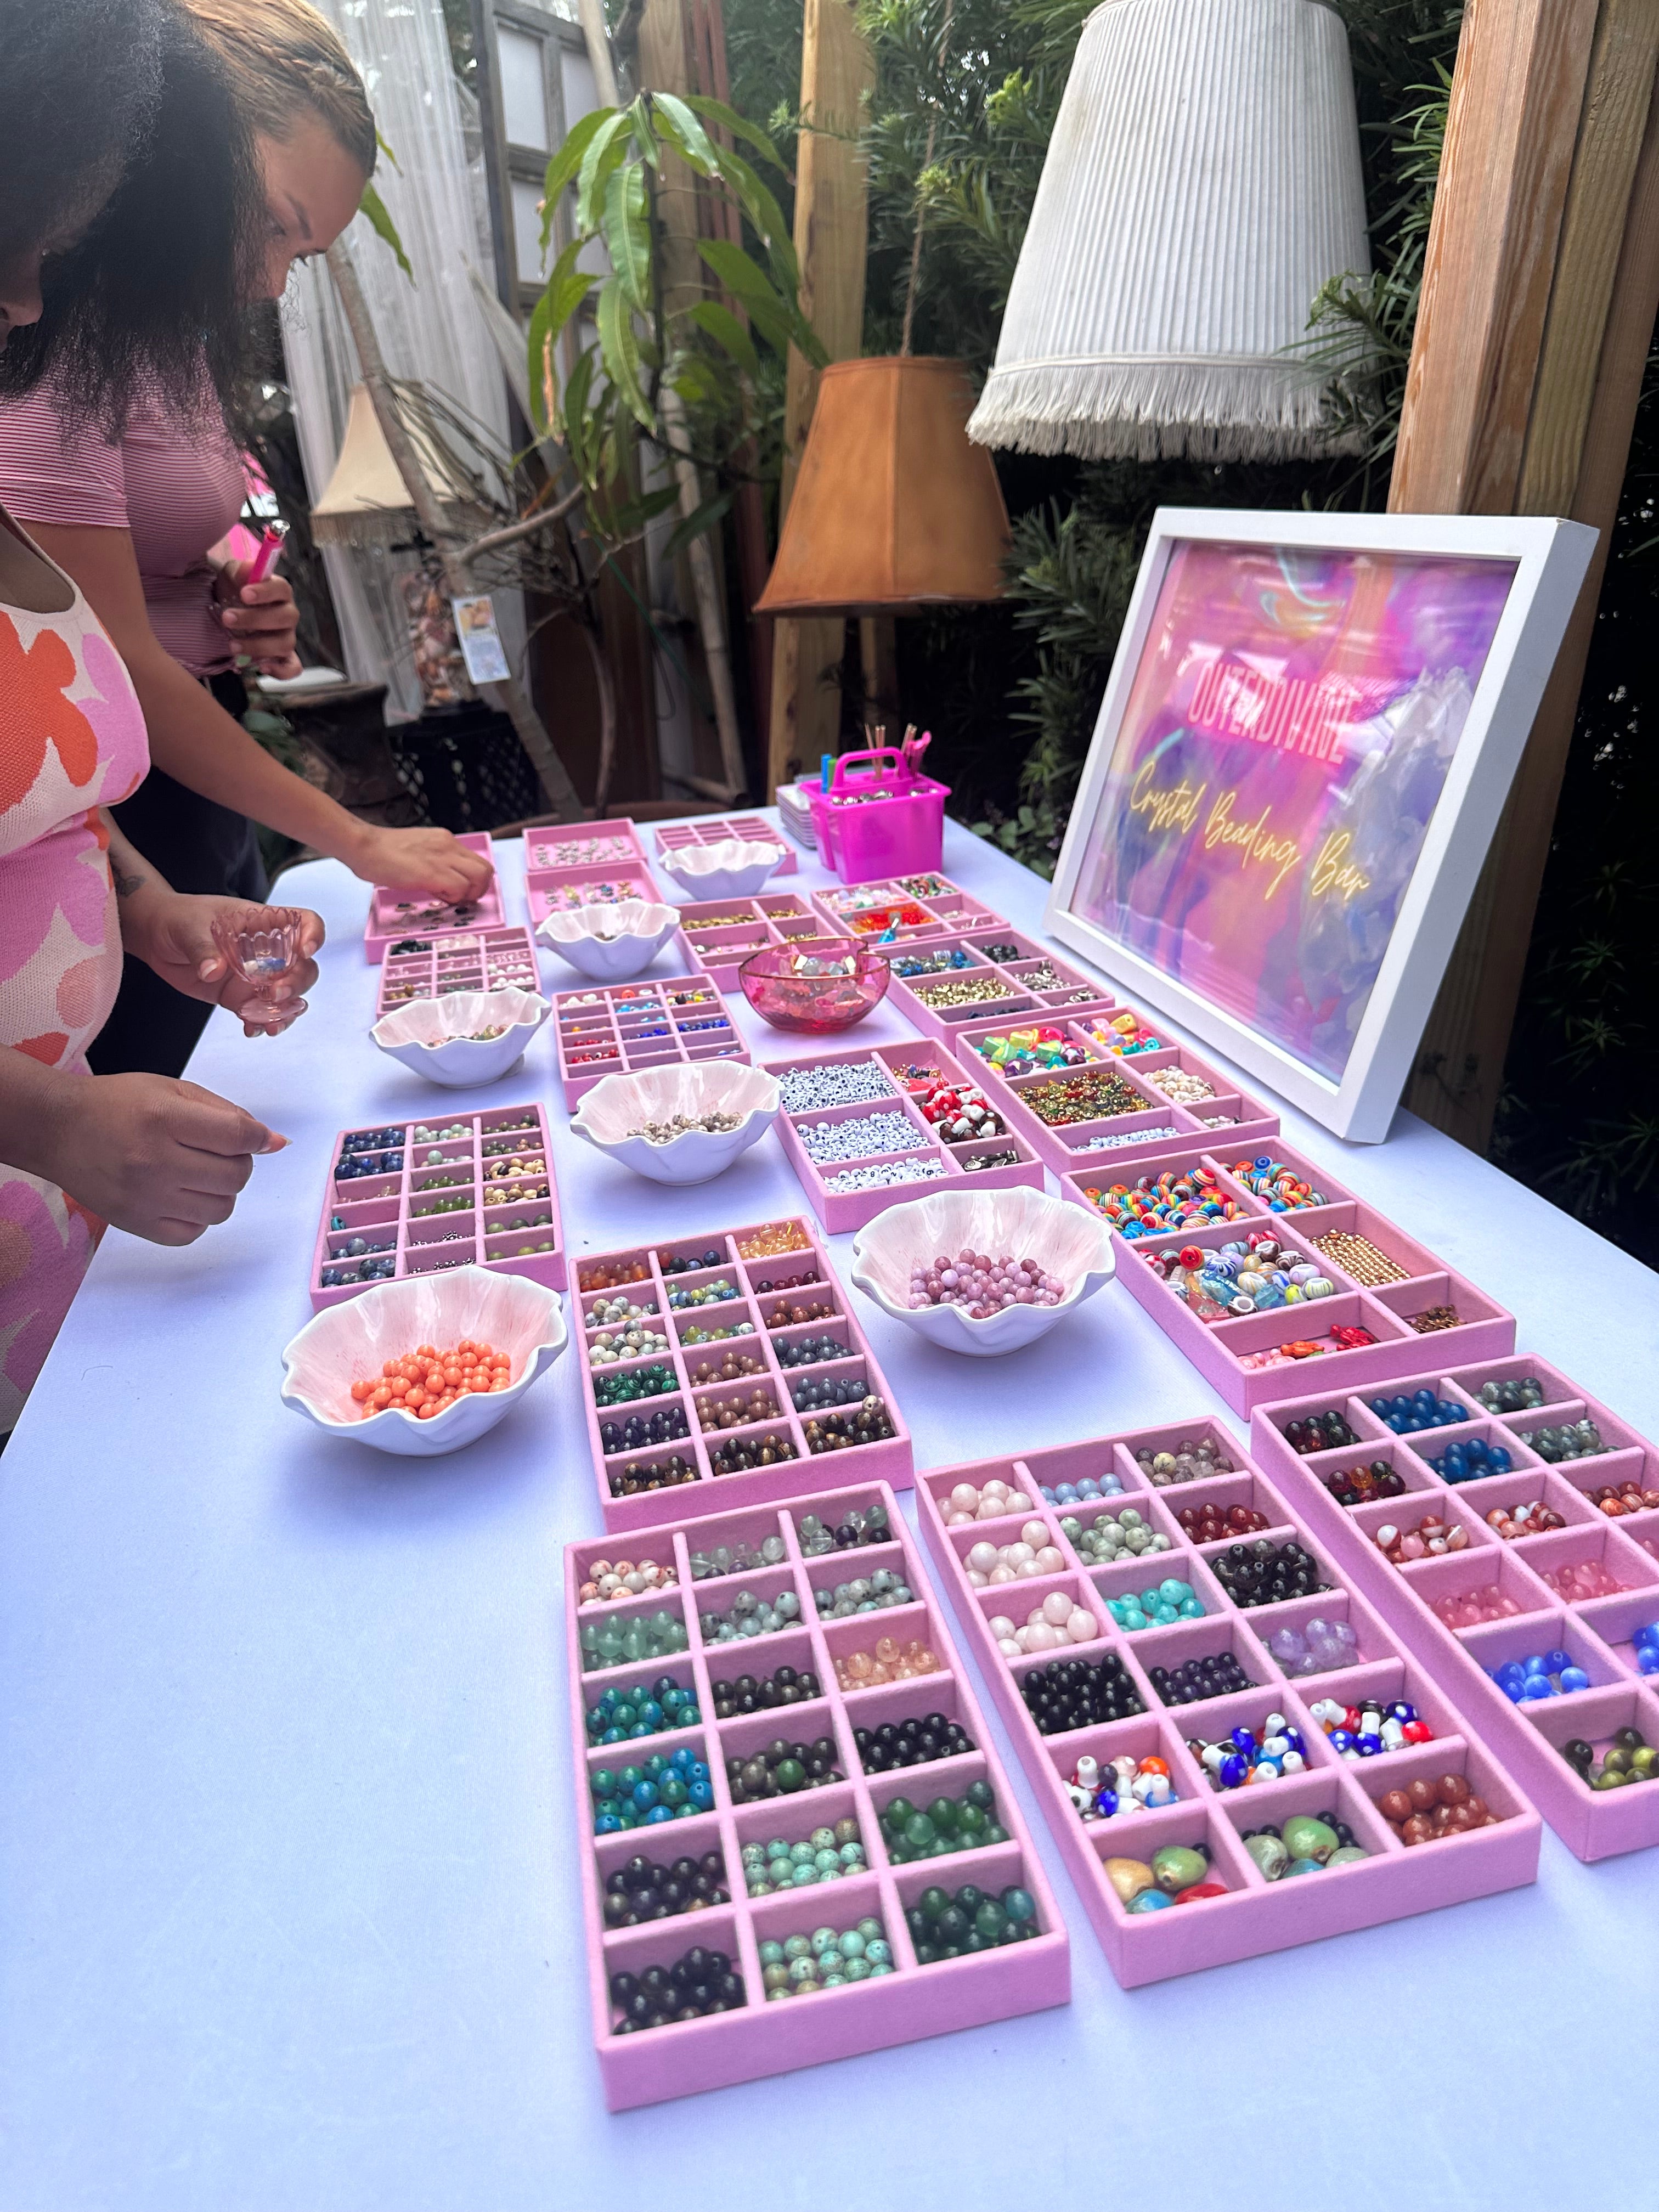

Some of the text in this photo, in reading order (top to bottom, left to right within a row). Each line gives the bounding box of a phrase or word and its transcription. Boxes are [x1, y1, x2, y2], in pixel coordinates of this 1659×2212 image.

[1130, 760, 1370, 900] Crystal Beading Bar
